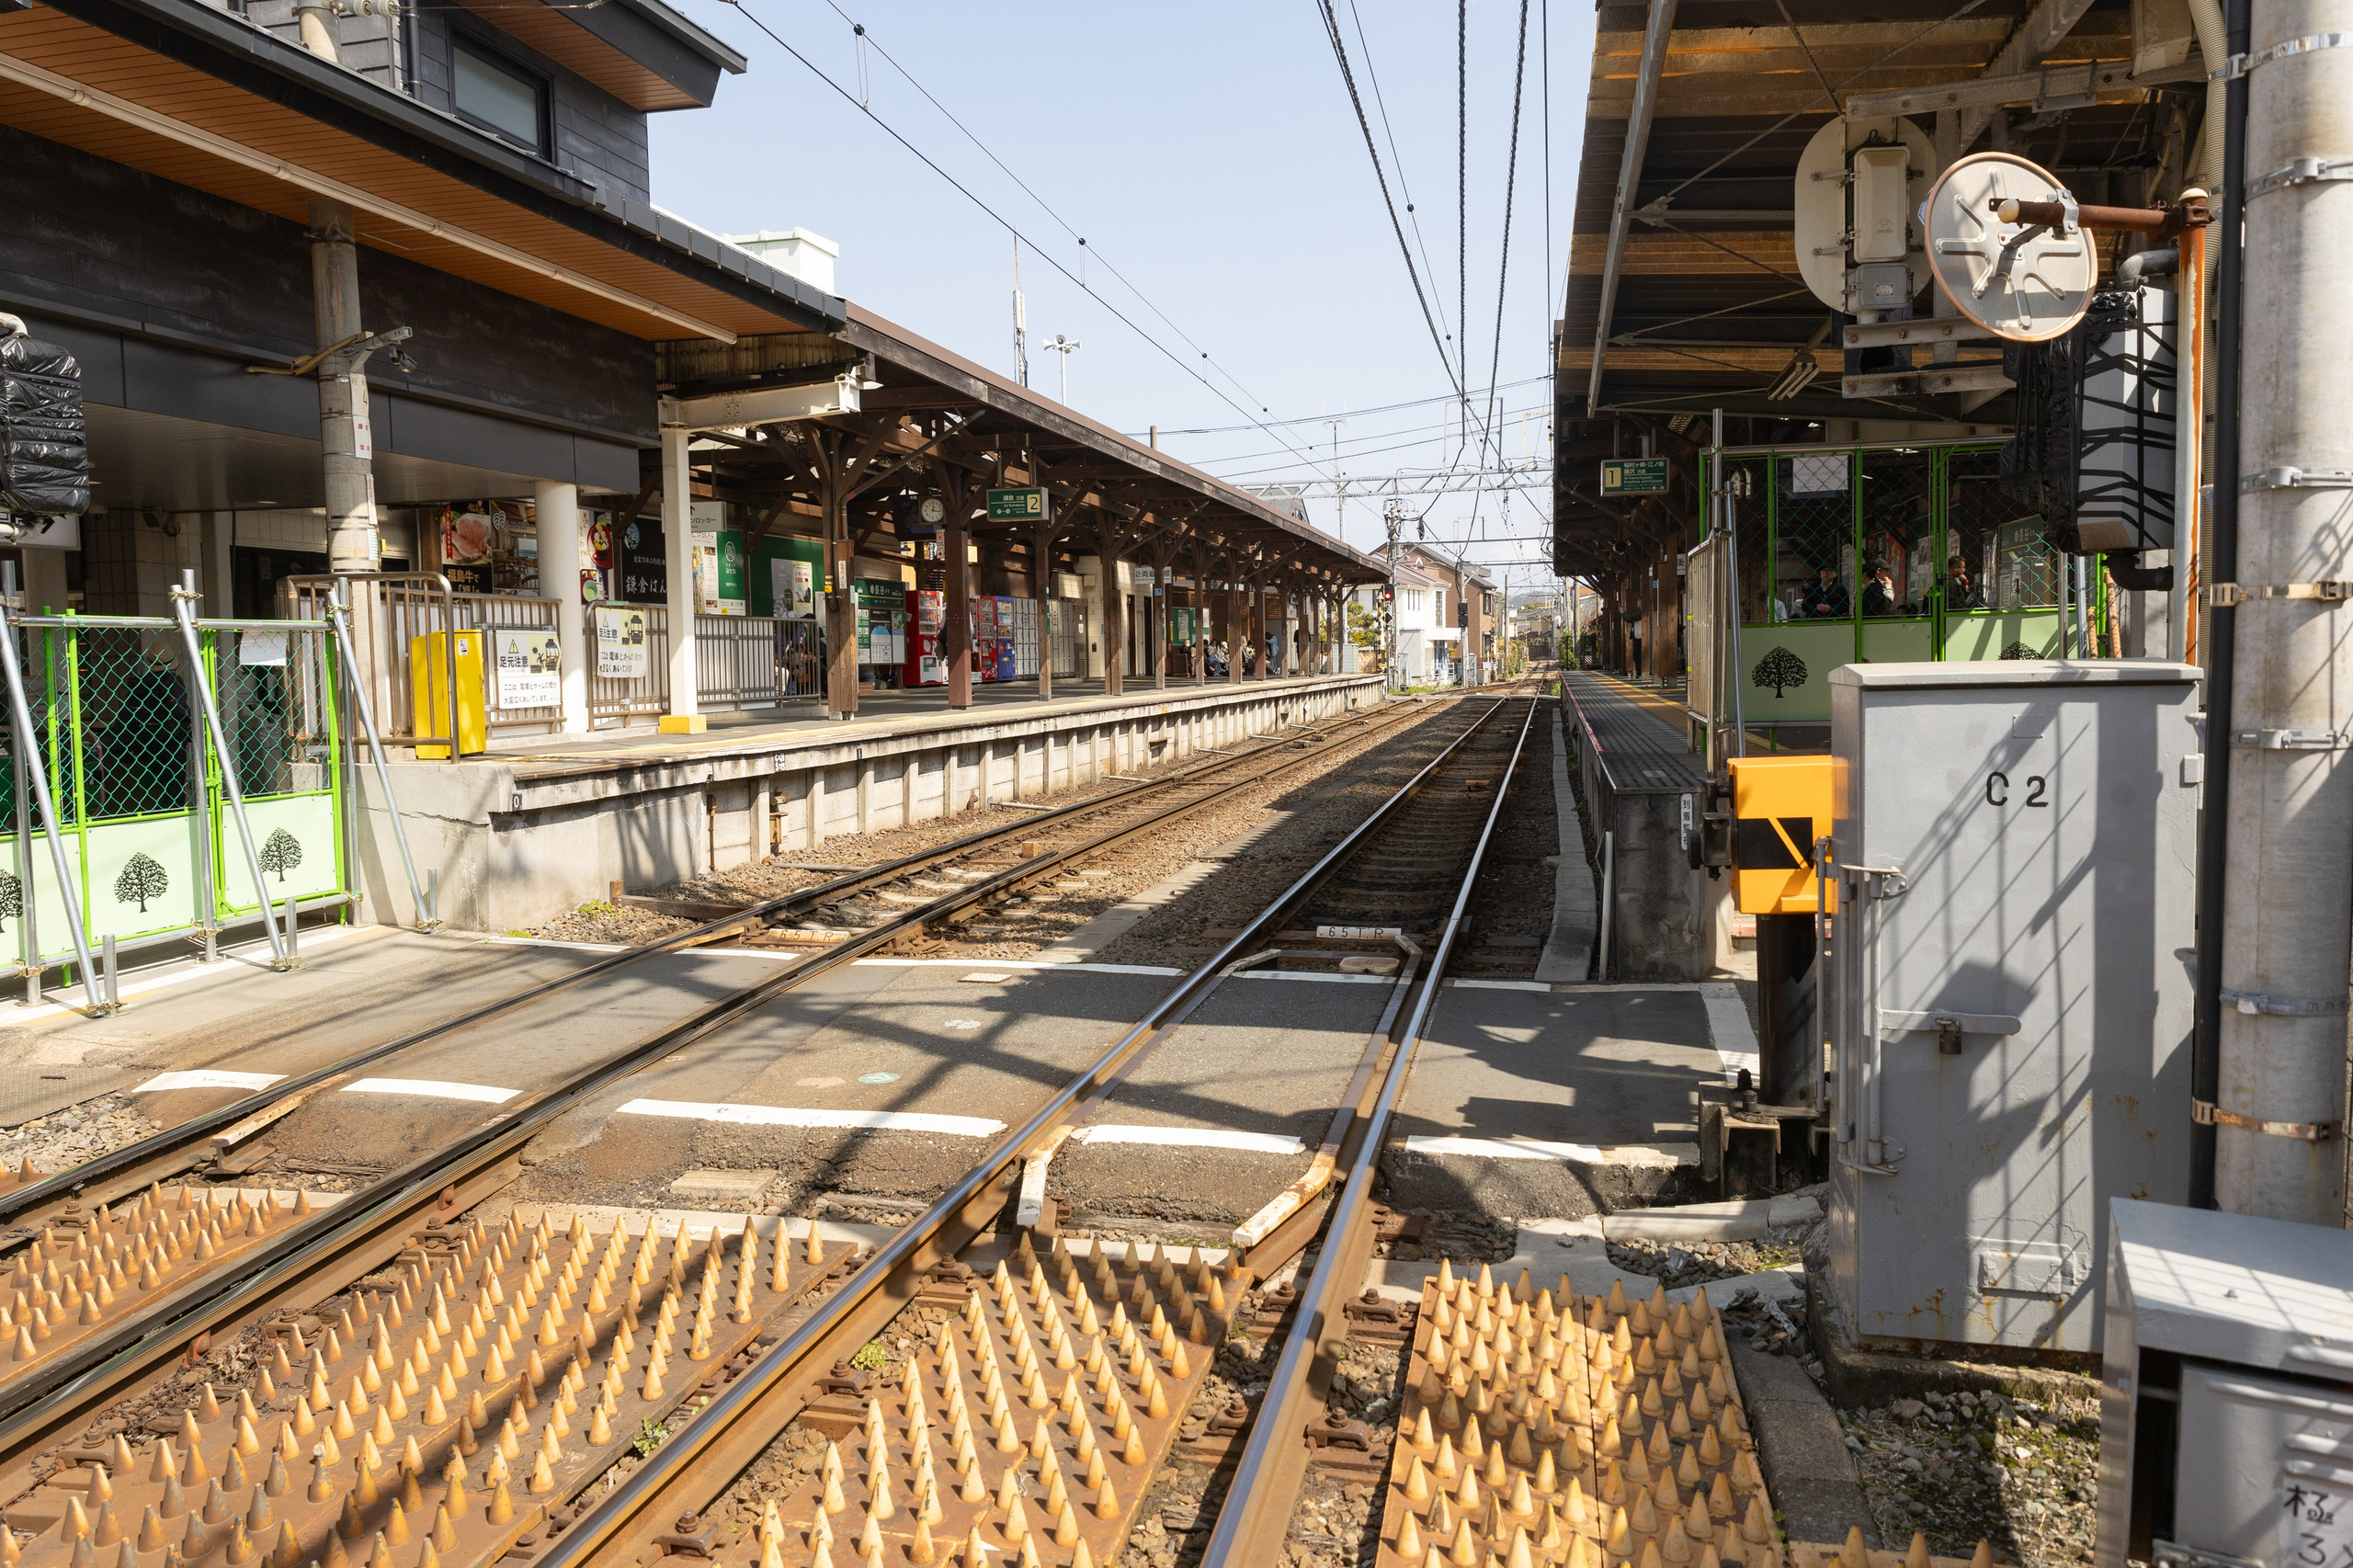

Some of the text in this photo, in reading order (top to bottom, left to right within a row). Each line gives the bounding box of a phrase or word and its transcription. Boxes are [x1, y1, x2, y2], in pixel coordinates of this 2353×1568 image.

[1608, 471, 1614, 484] 1
[1029, 496, 1039, 509] 2
[500, 656, 529, 667] 足元注意
